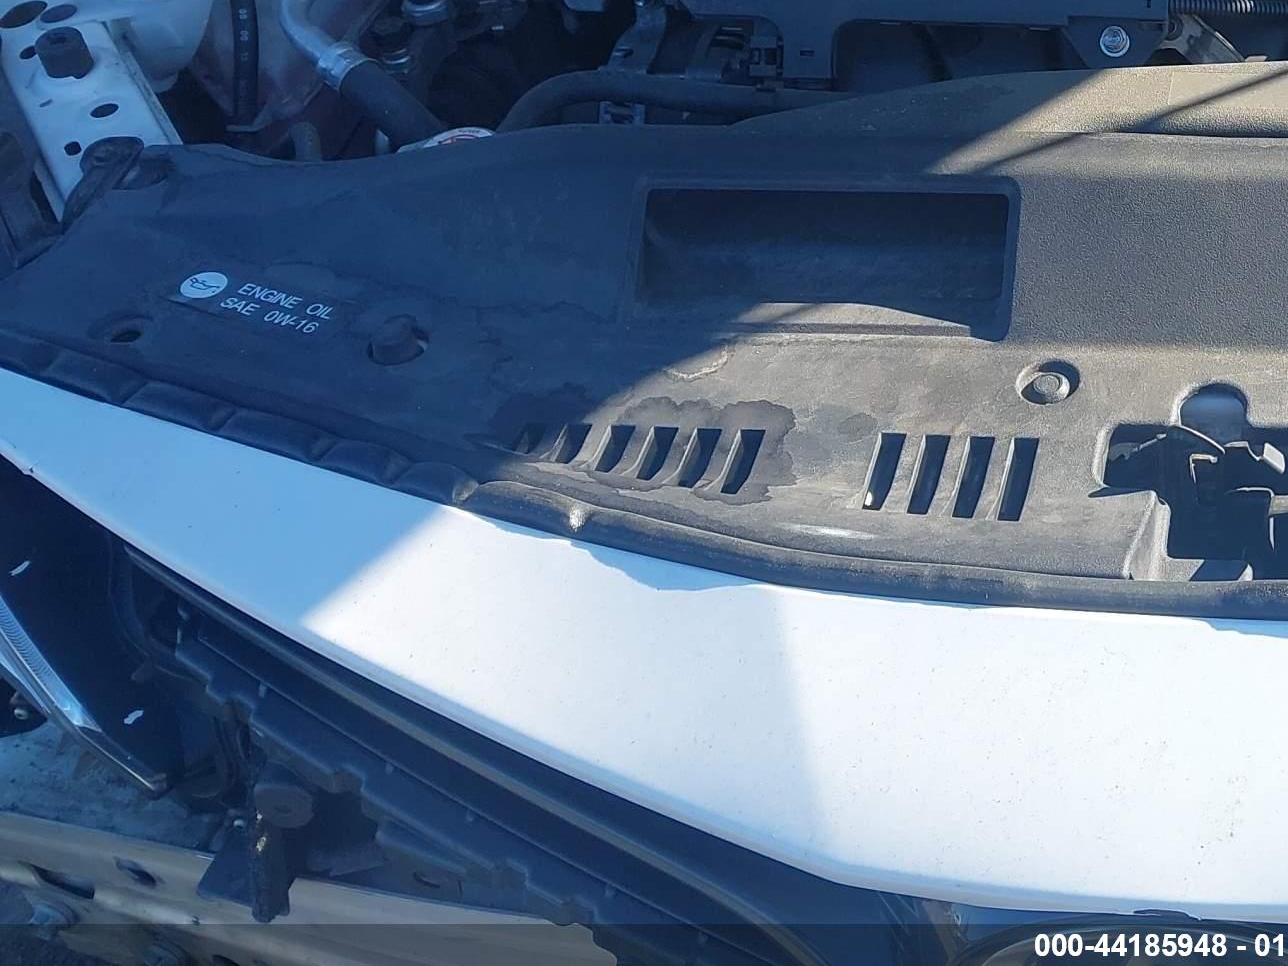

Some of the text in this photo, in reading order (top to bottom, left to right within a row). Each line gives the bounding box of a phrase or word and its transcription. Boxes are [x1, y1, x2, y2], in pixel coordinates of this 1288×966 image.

[220, 297, 319, 334] SAE 0W-16
[237, 283, 334, 320] ENGINE OIL
